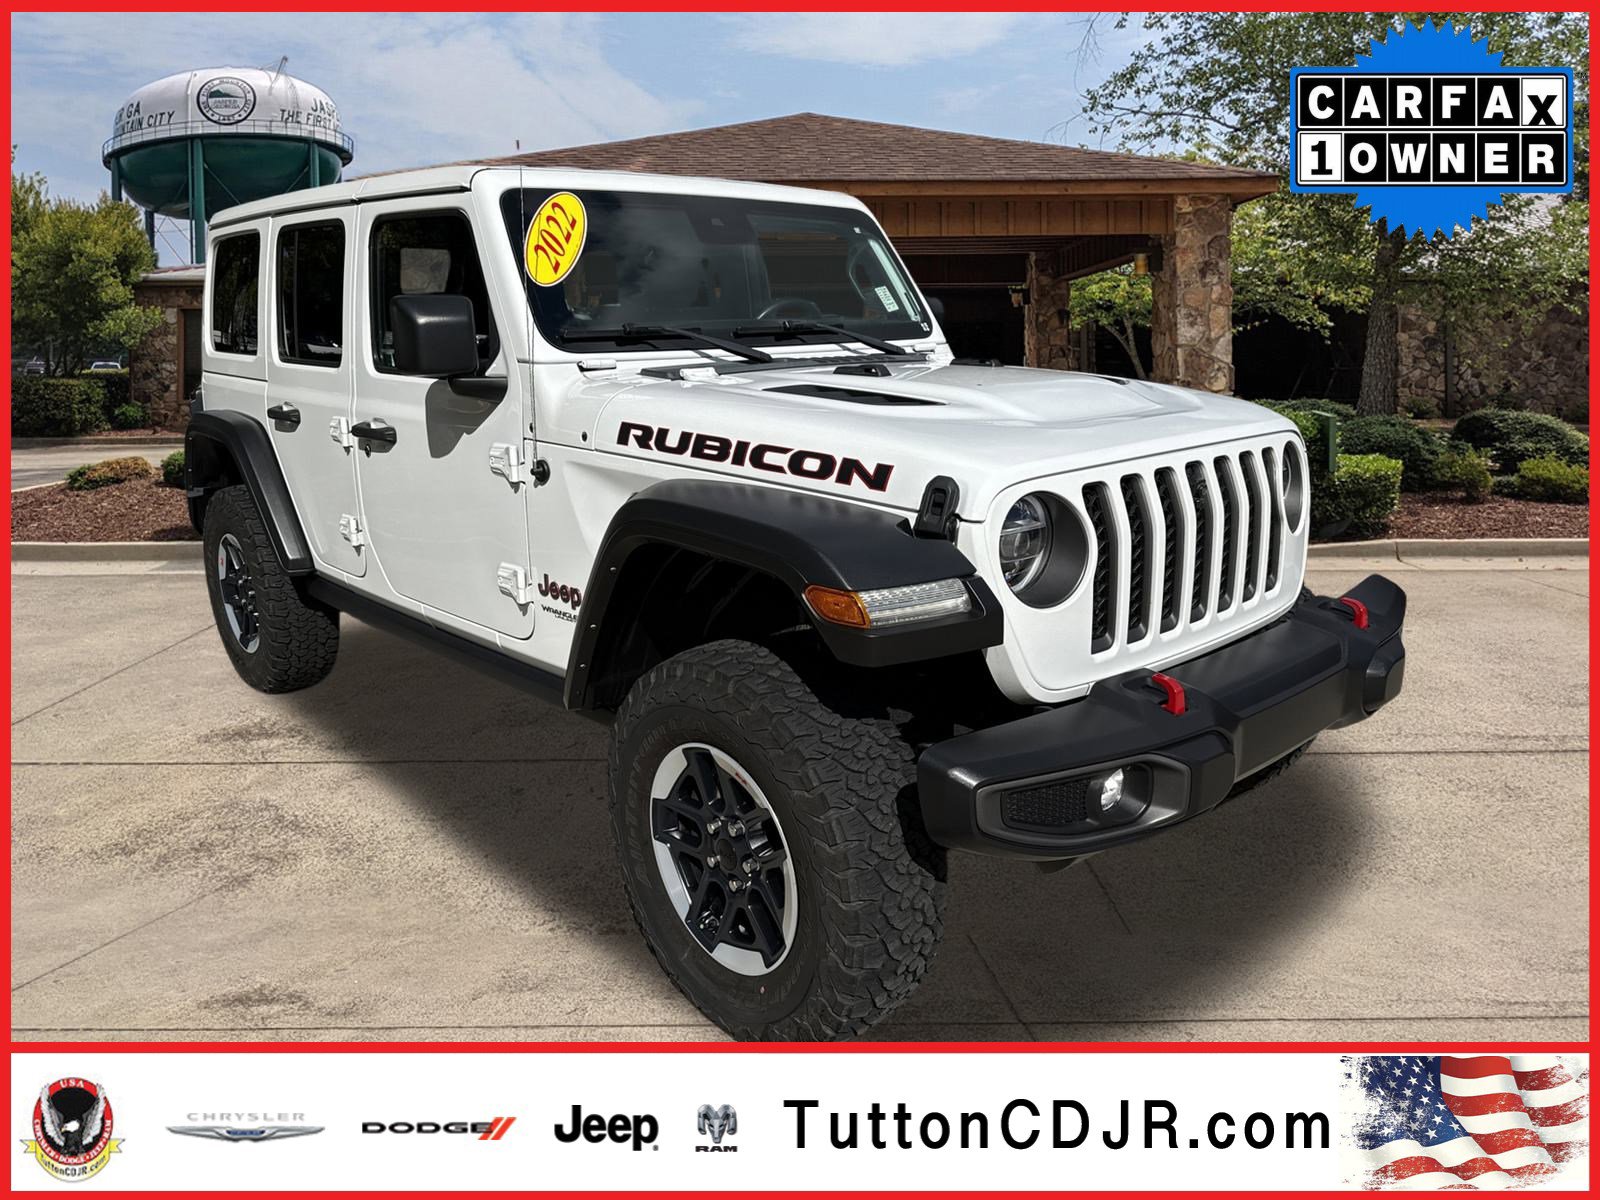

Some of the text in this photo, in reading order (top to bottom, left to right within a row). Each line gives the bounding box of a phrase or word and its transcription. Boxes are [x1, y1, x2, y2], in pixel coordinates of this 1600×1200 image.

[147, 110, 175, 127] CITY
[280, 109, 302, 124] THE
[534, 202, 577, 275] 2022
[616, 421, 894, 492] RUBICON
[538, 573, 582, 610] Jeep
[541, 604, 578, 620] WRANGLE
